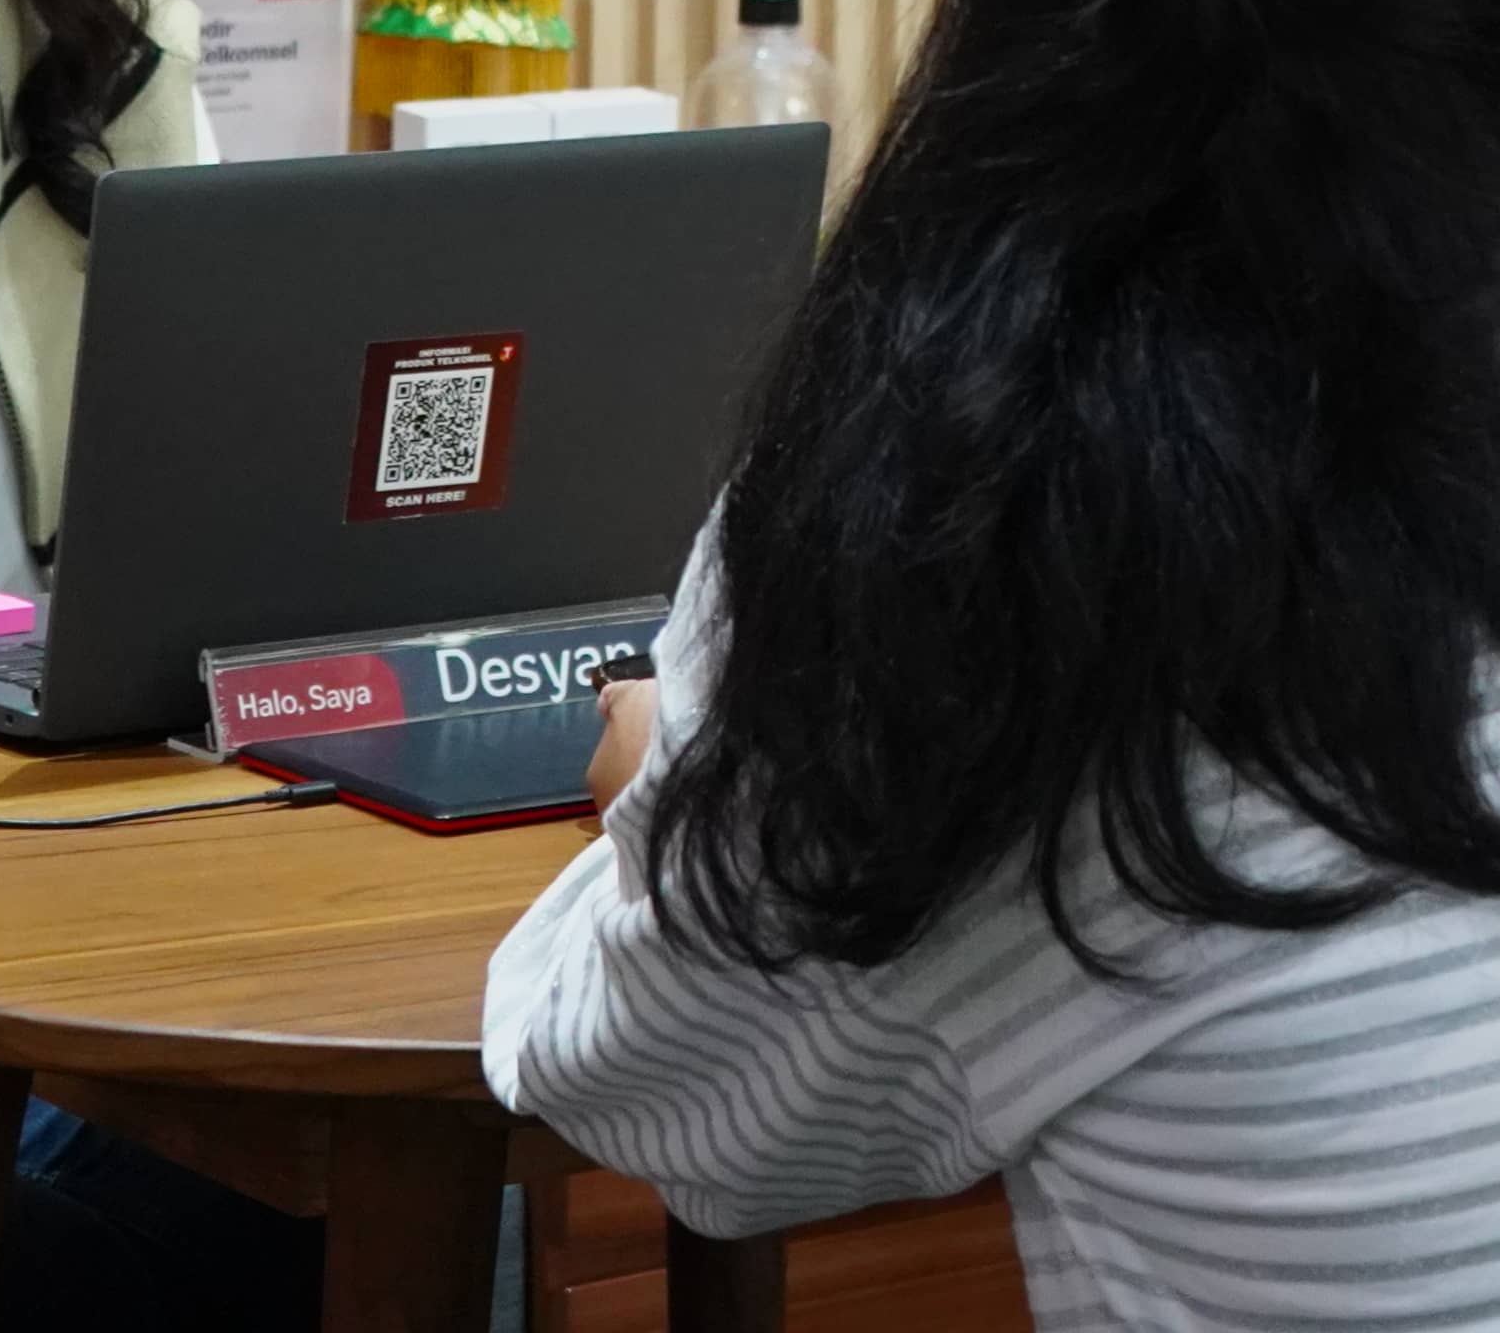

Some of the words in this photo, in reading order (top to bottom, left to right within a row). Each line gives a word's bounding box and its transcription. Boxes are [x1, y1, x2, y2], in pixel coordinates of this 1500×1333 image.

[200, 40, 297, 64] elkomsel
[386, 495, 422, 508] SCAN
[236, 690, 305, 721] Halo,
[308, 681, 372, 714] Saya
